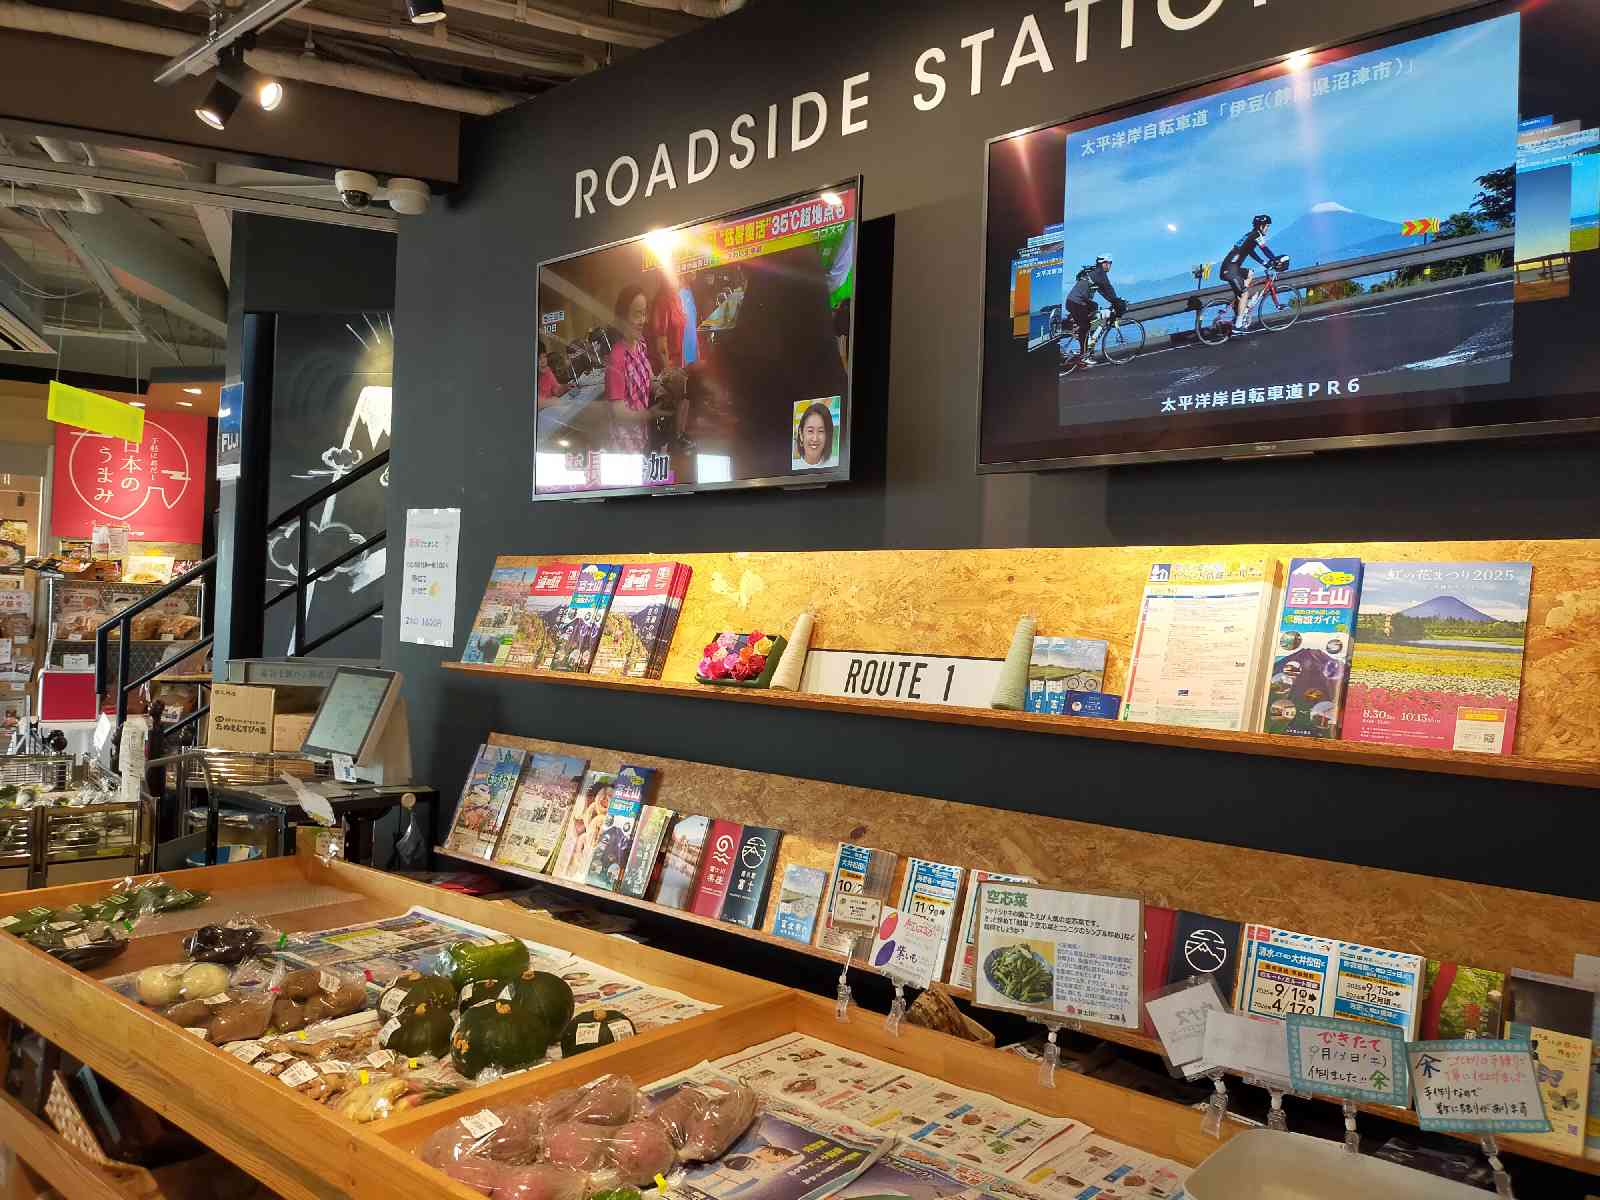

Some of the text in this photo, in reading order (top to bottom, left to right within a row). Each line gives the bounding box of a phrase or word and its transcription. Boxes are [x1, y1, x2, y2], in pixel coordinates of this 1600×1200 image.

[573, 0, 1267, 219] ROADSIDE STATIO
[1080, 56, 1417, 157] 太平洋岸自転車道 「伊豆(静県沼津市)」
[93, 447, 115, 504] うまみ
[1291, 587, 1350, 606] 富士山
[844, 659, 956, 702] ROUTE 1
[1317, 1030, 1384, 1051] できたて
